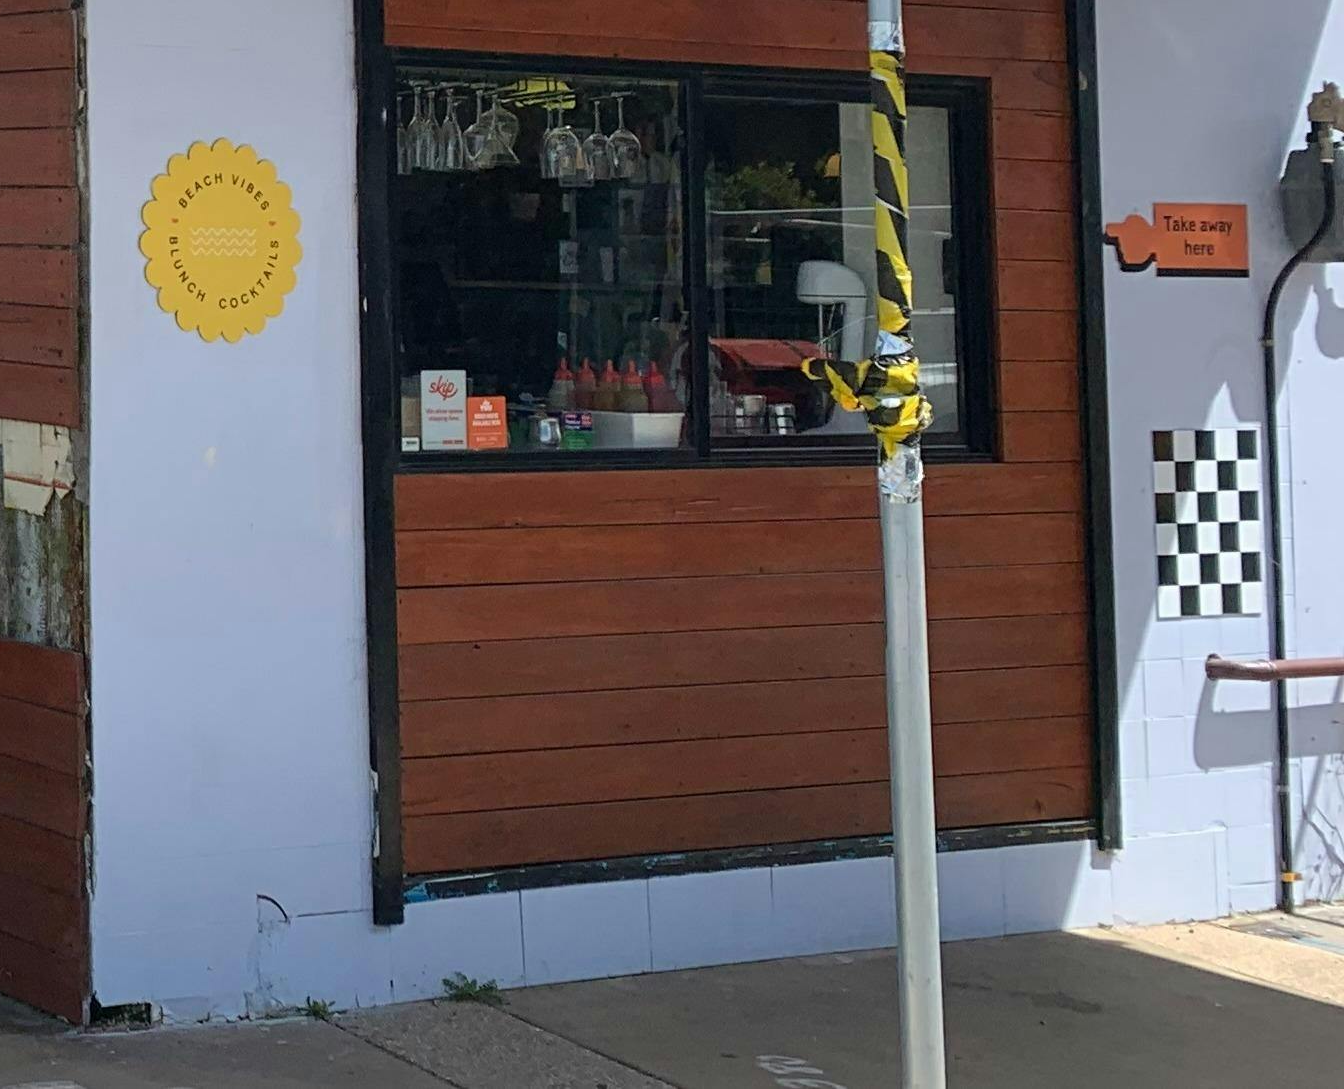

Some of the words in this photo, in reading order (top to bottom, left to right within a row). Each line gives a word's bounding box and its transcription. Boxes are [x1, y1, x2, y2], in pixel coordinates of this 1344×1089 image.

[178, 172, 223, 209] BEACH
[231, 174, 270, 211] VIBES
[1163, 216, 1196, 232] Take
[1200, 219, 1233, 234] away
[1184, 240, 1215, 256] here
[169, 236, 207, 302] BLUNCH
[218, 240, 279, 310] COCKTAILS
